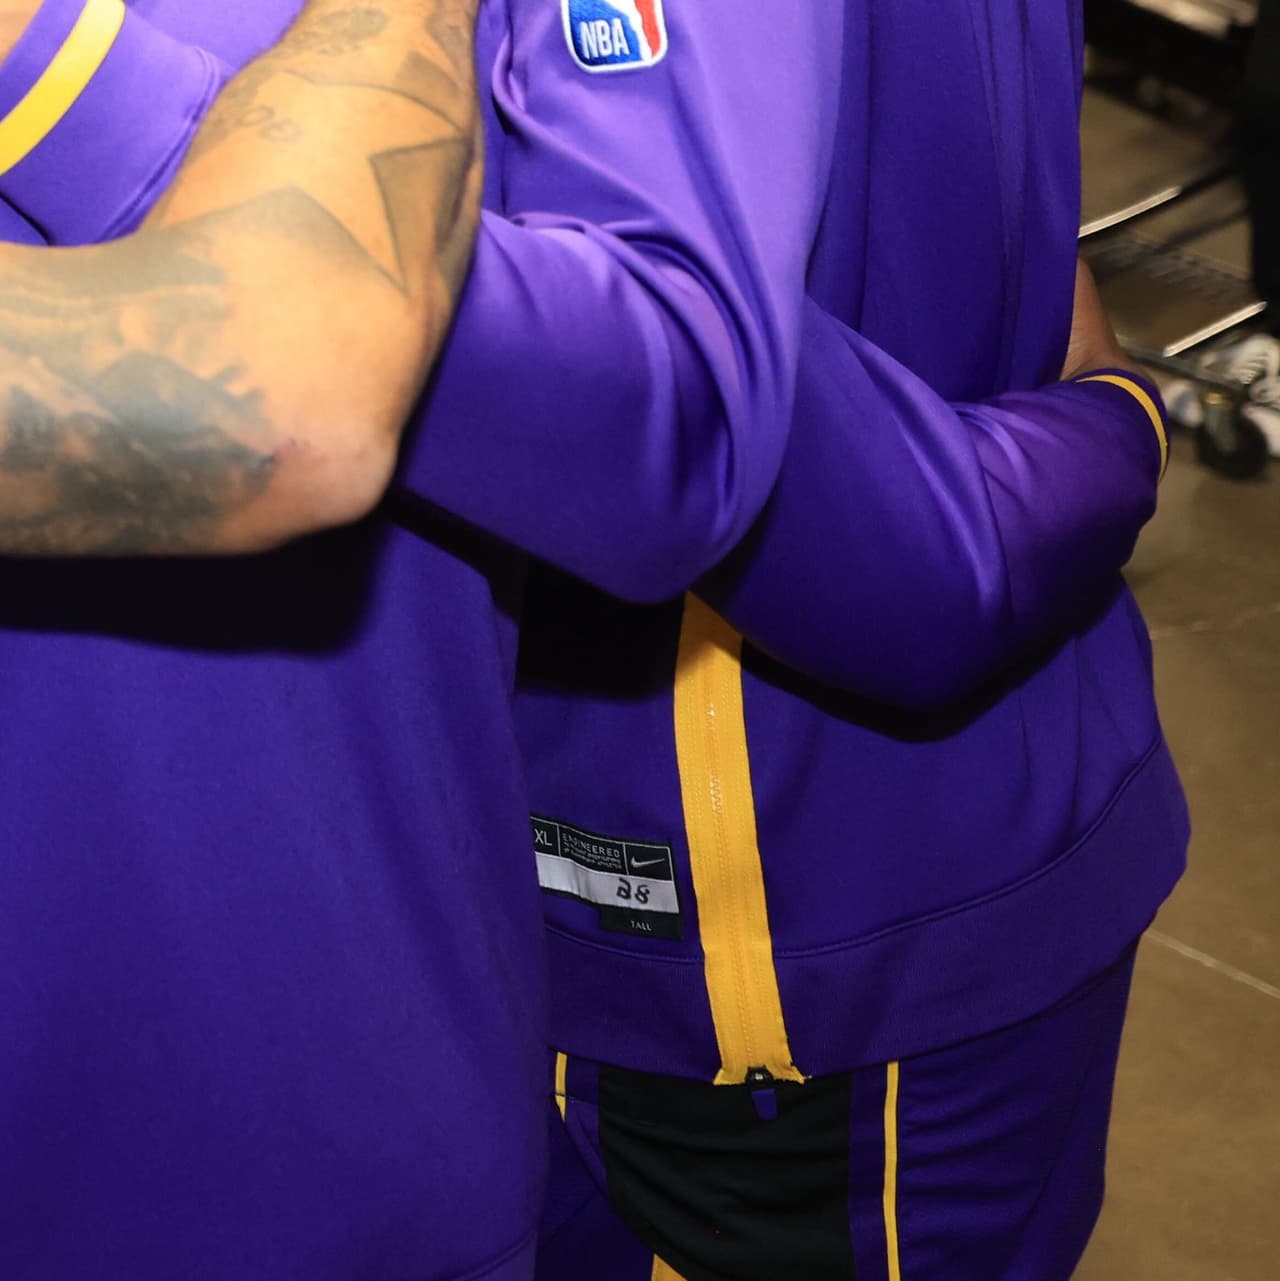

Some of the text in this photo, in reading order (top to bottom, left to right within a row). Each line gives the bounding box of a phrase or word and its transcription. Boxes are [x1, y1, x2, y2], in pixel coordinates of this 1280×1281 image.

[579, 17, 630, 59] NBA
[534, 828, 553, 847] XL
[630, 920, 652, 932] TALL
